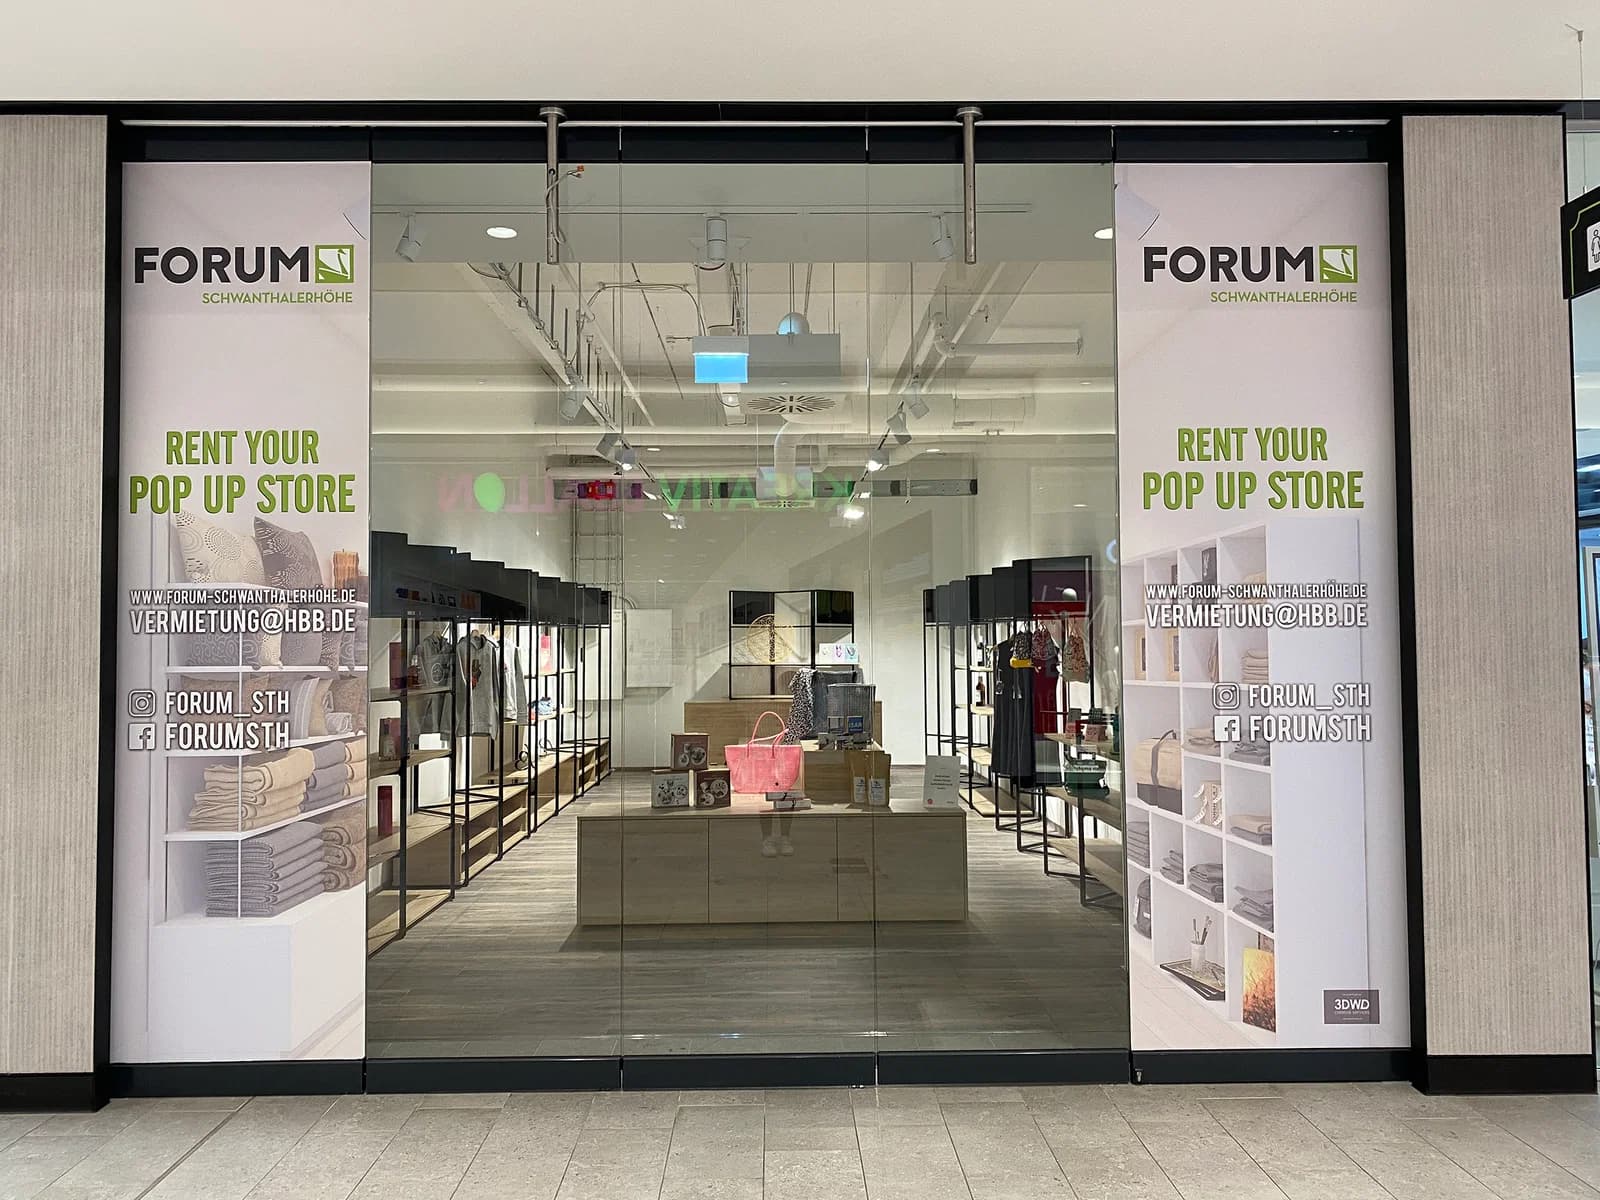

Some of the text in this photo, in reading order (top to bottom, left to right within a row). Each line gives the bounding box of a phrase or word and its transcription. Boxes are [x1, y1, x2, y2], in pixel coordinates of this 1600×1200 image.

[134, 246, 309, 284] FORUM
[1143, 246, 1314, 283] FORUM
[202, 289, 353, 304] SCHWANTHALERHÖHE
[1210, 289, 1357, 303] SCHWANTHALERHÖHE
[166, 429, 319, 465] RENT YOUR
[1177, 427, 1328, 462] RENT YOUR
[129, 473, 356, 514] POP UP STORE
[1143, 470, 1364, 510] POP UP STORE
[130, 584, 356, 605] WWW.FORUM-SCHWANTHALERHÖHE.DE
[1146, 580, 1367, 599] WWW.FORUM-SCHWANTHALERHÖHE.DE
[130, 608, 356, 634] VERMIETUNG@HBB.DE
[1146, 602, 1368, 629] VERMIETUNG@HBB.DE
[165, 690, 290, 718] FORUM_STH
[1249, 683, 1370, 710] FORUM_STH
[165, 722, 290, 750] FORUMSTH
[1249, 714, 1371, 742] FORUMSTH
[1334, 998, 1370, 1010] 3DWD
